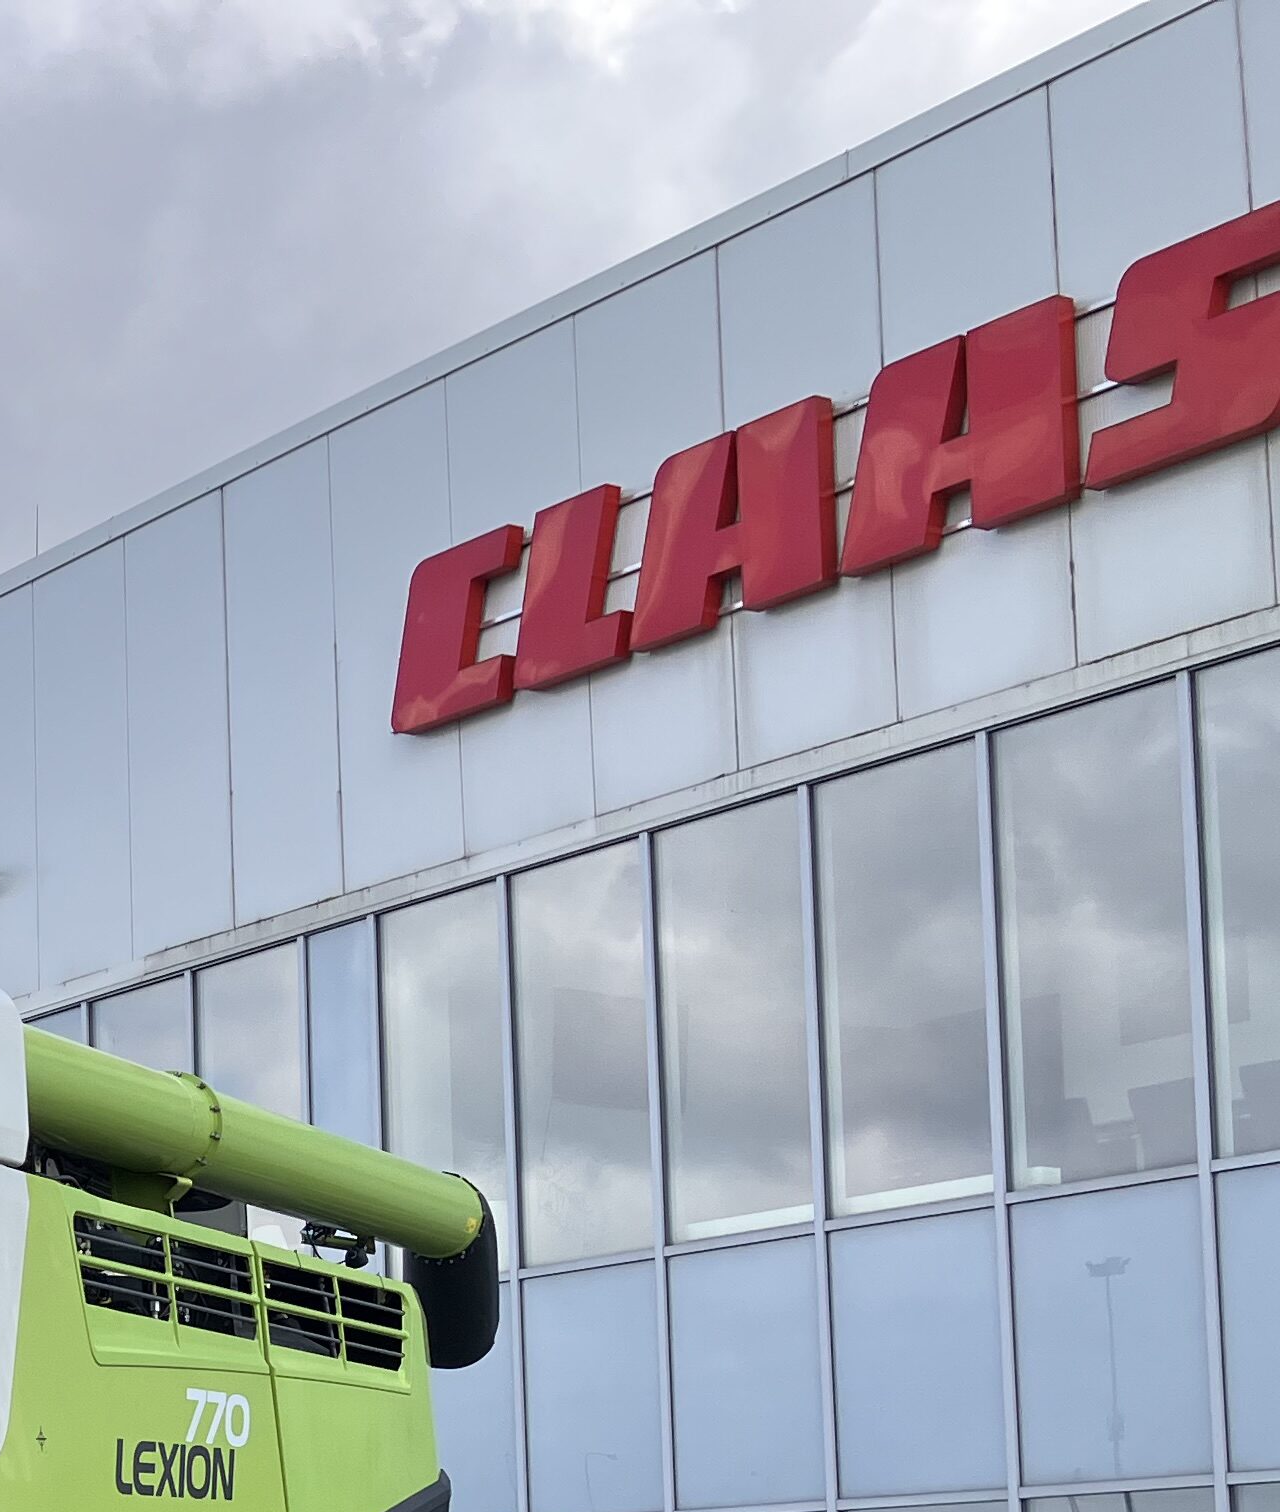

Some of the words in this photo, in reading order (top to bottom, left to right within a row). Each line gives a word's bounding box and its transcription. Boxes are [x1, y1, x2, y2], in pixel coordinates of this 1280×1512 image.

[391, 203, 1280, 735] CLAAS
[185, 1387, 251, 1448] 770
[115, 1438, 236, 1501] LEXION
